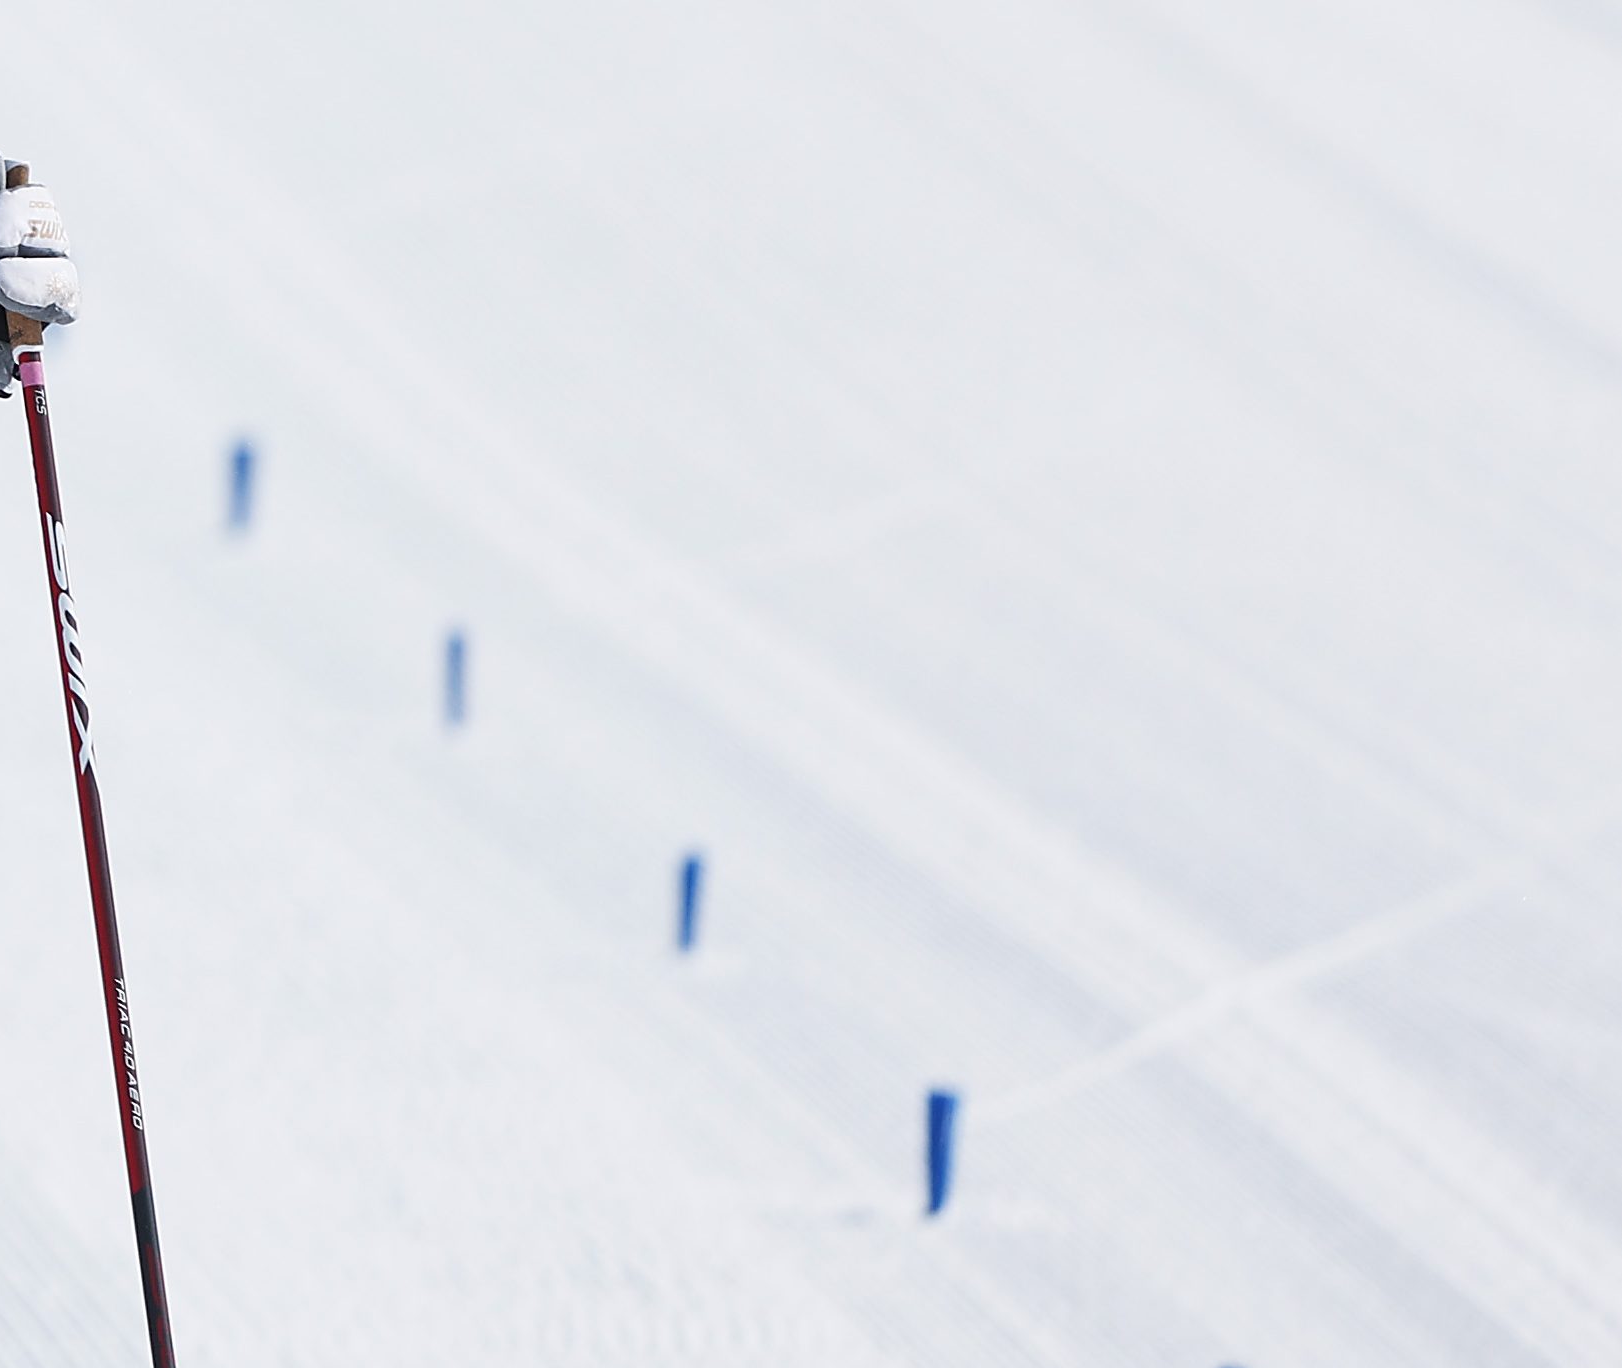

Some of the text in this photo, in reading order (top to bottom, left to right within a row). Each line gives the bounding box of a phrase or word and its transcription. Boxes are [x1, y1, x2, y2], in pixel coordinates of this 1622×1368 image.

[34, 389, 47, 416] TCS
[114, 977, 144, 1130] TRIAC 4.0 AERO
